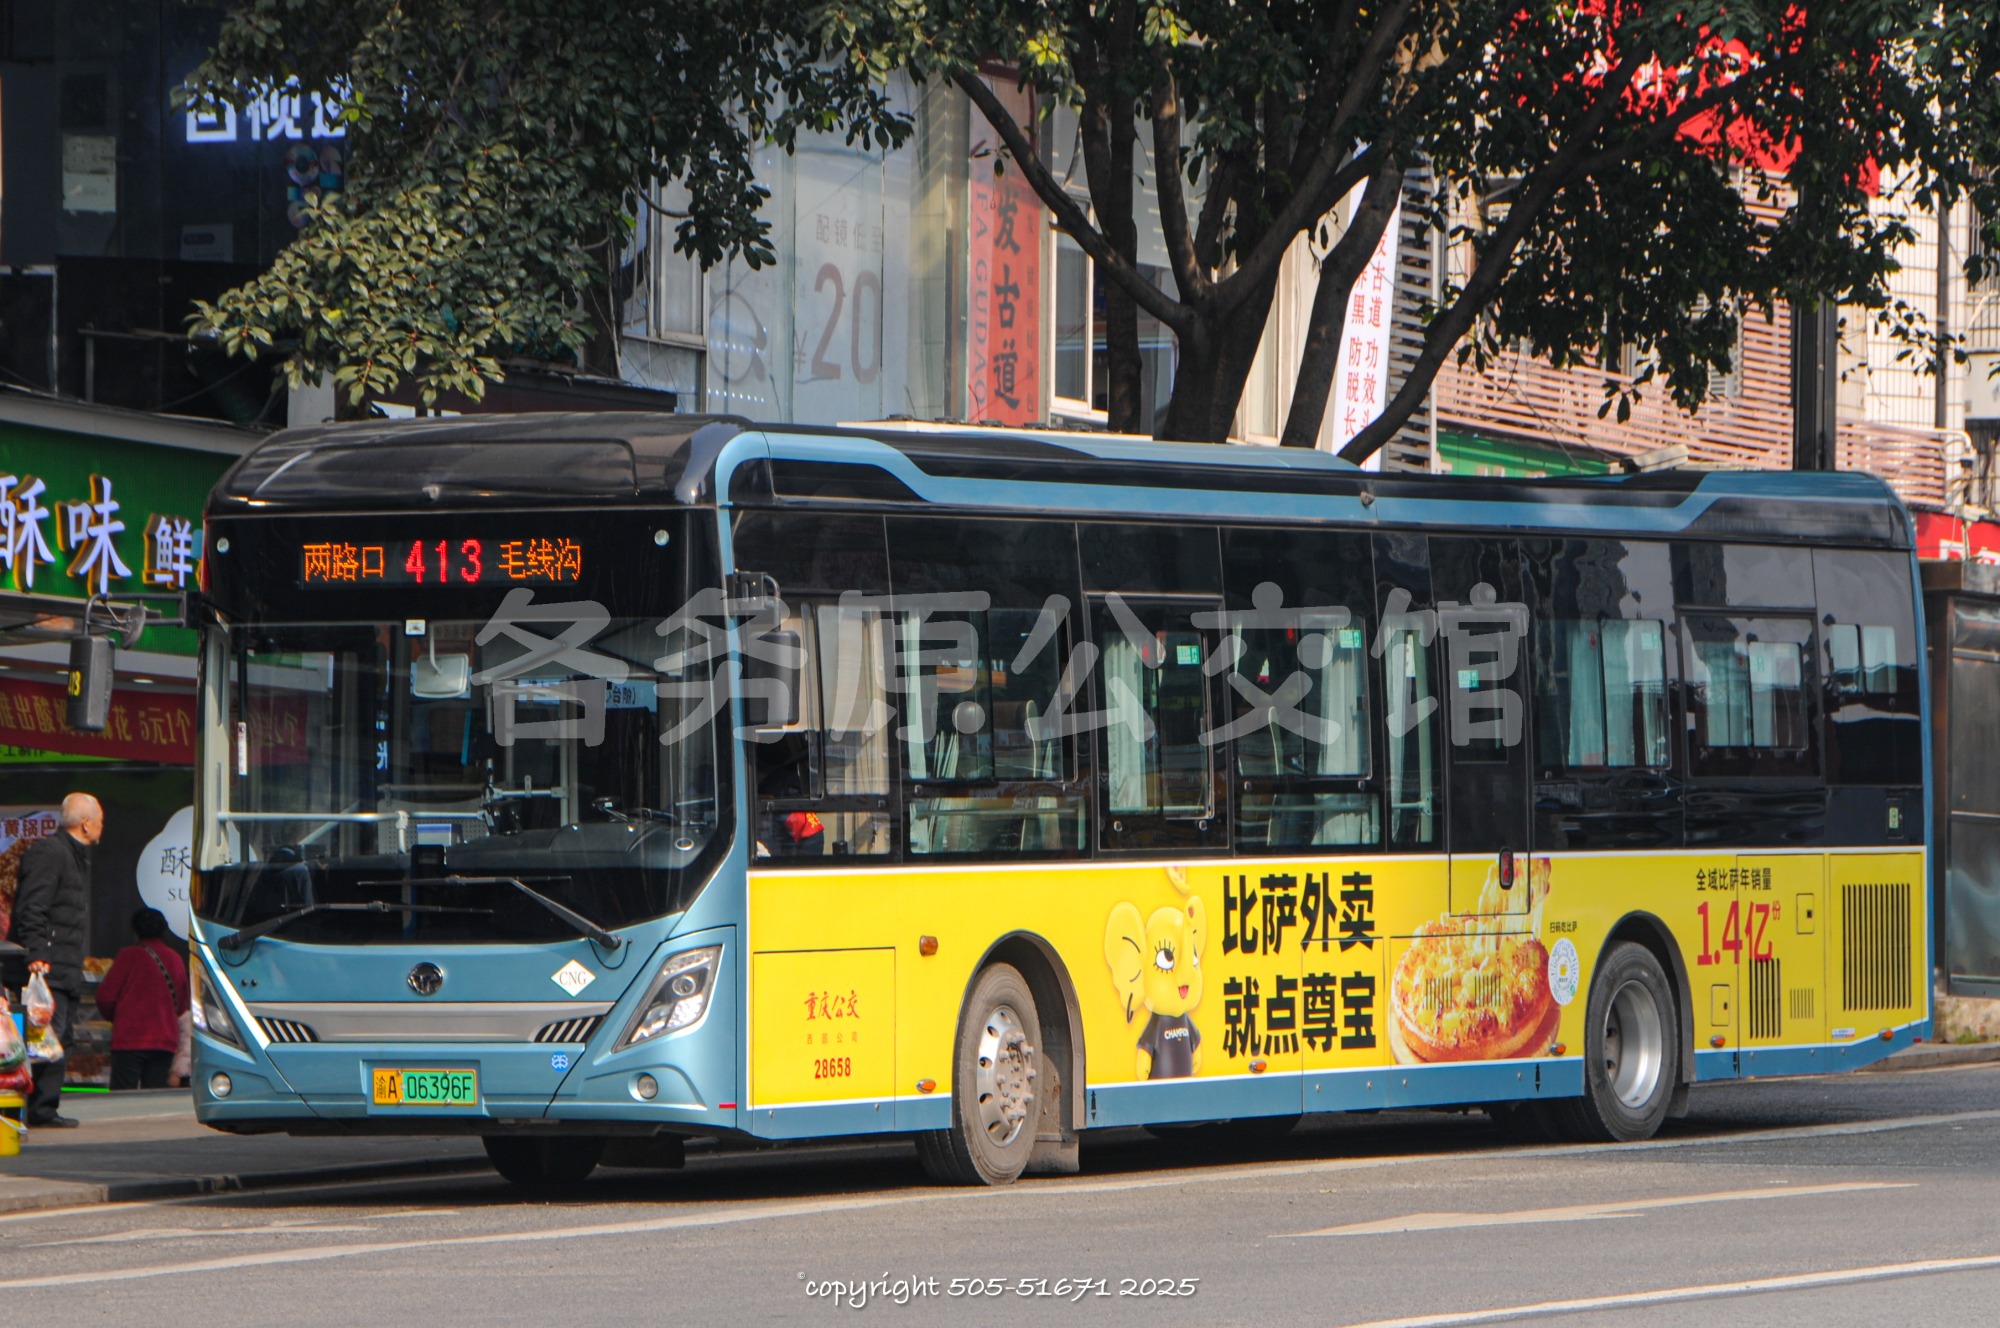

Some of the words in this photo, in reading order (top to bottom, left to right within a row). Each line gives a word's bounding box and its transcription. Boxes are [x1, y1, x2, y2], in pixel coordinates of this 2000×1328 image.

[303, 542, 384, 583] 两路口
[405, 539, 482, 584] 413
[498, 538, 582, 582] 毛线沟
[0, 818, 57, 838] 黄锅巴
[1696, 867, 1772, 892] 全域比萨年销量
[1221, 871, 1375, 956] 比萨外卖
[559, 971, 586, 986] CNG
[803, 989, 860, 1021] 重庆公交
[1222, 971, 1377, 1060] 就点尊宝
[814, 1056, 851, 1079] 28658
